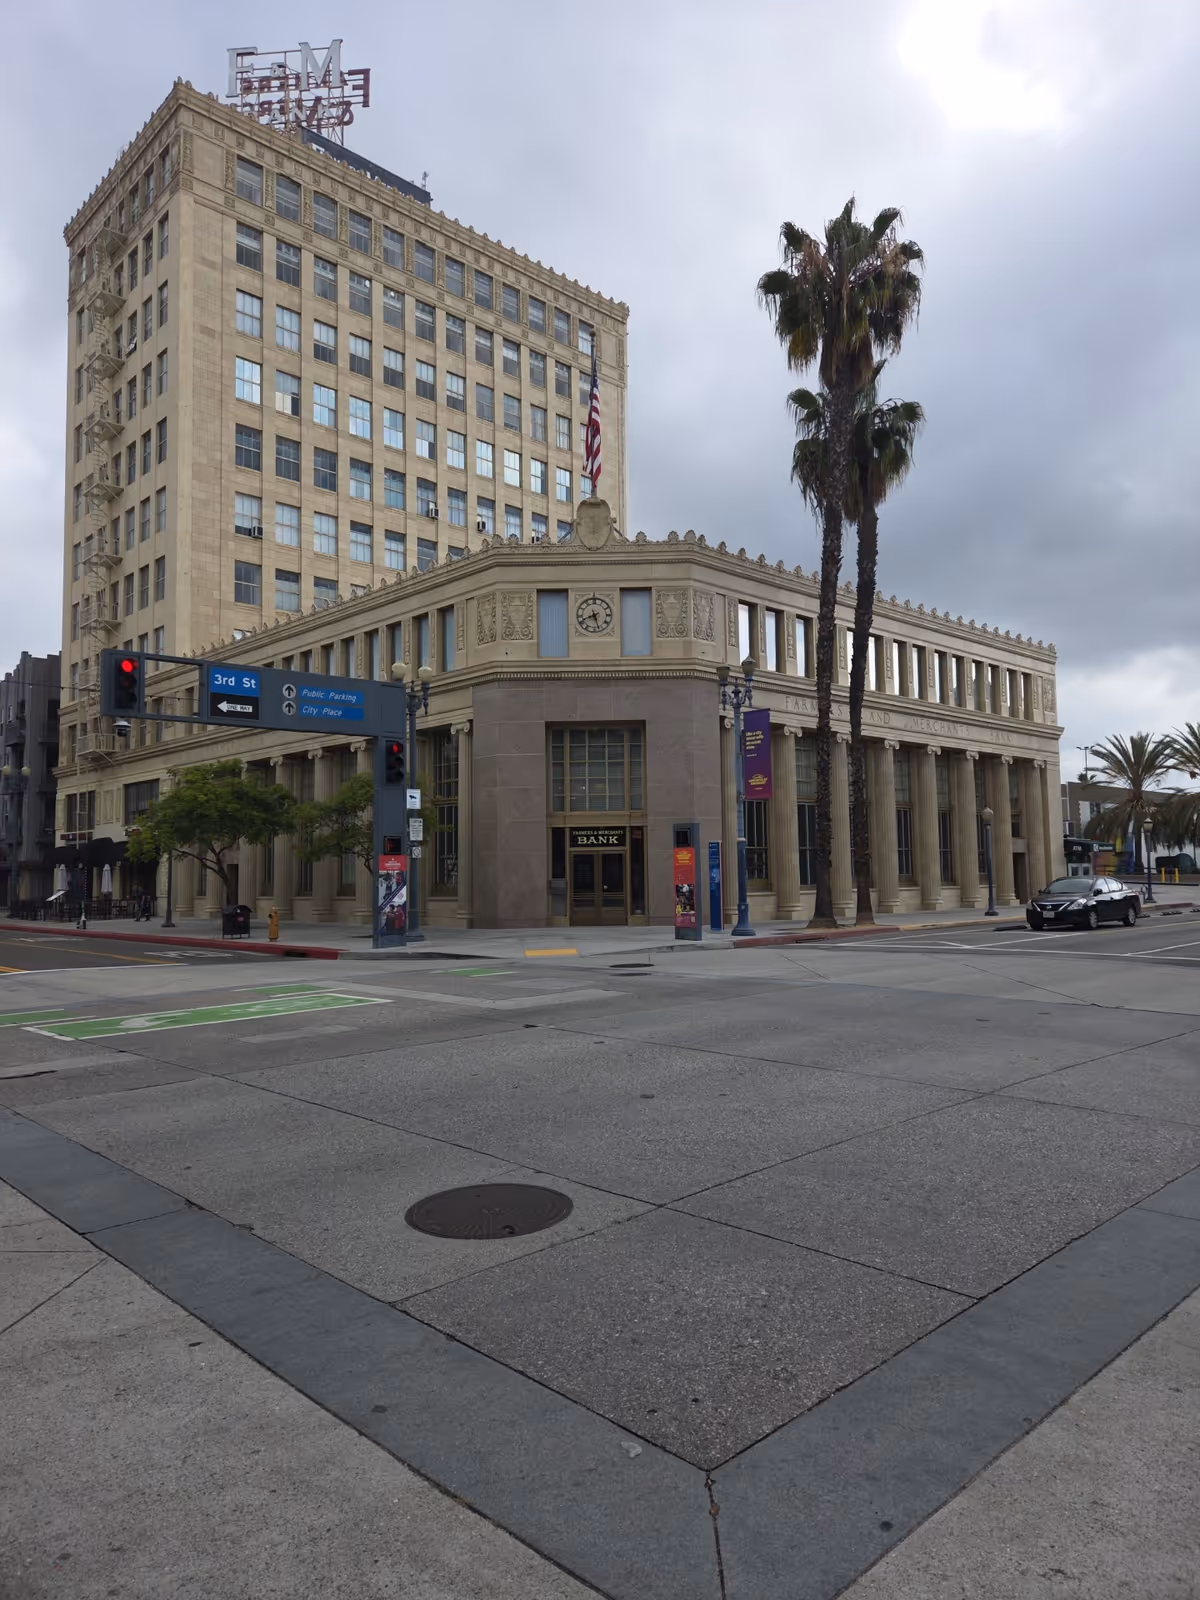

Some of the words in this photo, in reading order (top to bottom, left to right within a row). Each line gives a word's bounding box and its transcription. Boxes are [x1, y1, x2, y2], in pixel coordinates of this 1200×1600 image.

[214, 674, 235, 686] 3rd
[242, 677, 256, 689] St
[301, 689, 325, 699] Public
[328, 691, 357, 703] Parking
[302, 705, 319, 716] City
[322, 707, 343, 717] Place
[785, 695, 843, 717] FARMS
[868, 711, 891, 725] AND
[911, 718, 970, 737] MERCHANTS
[577, 836, 619, 844] BANK
